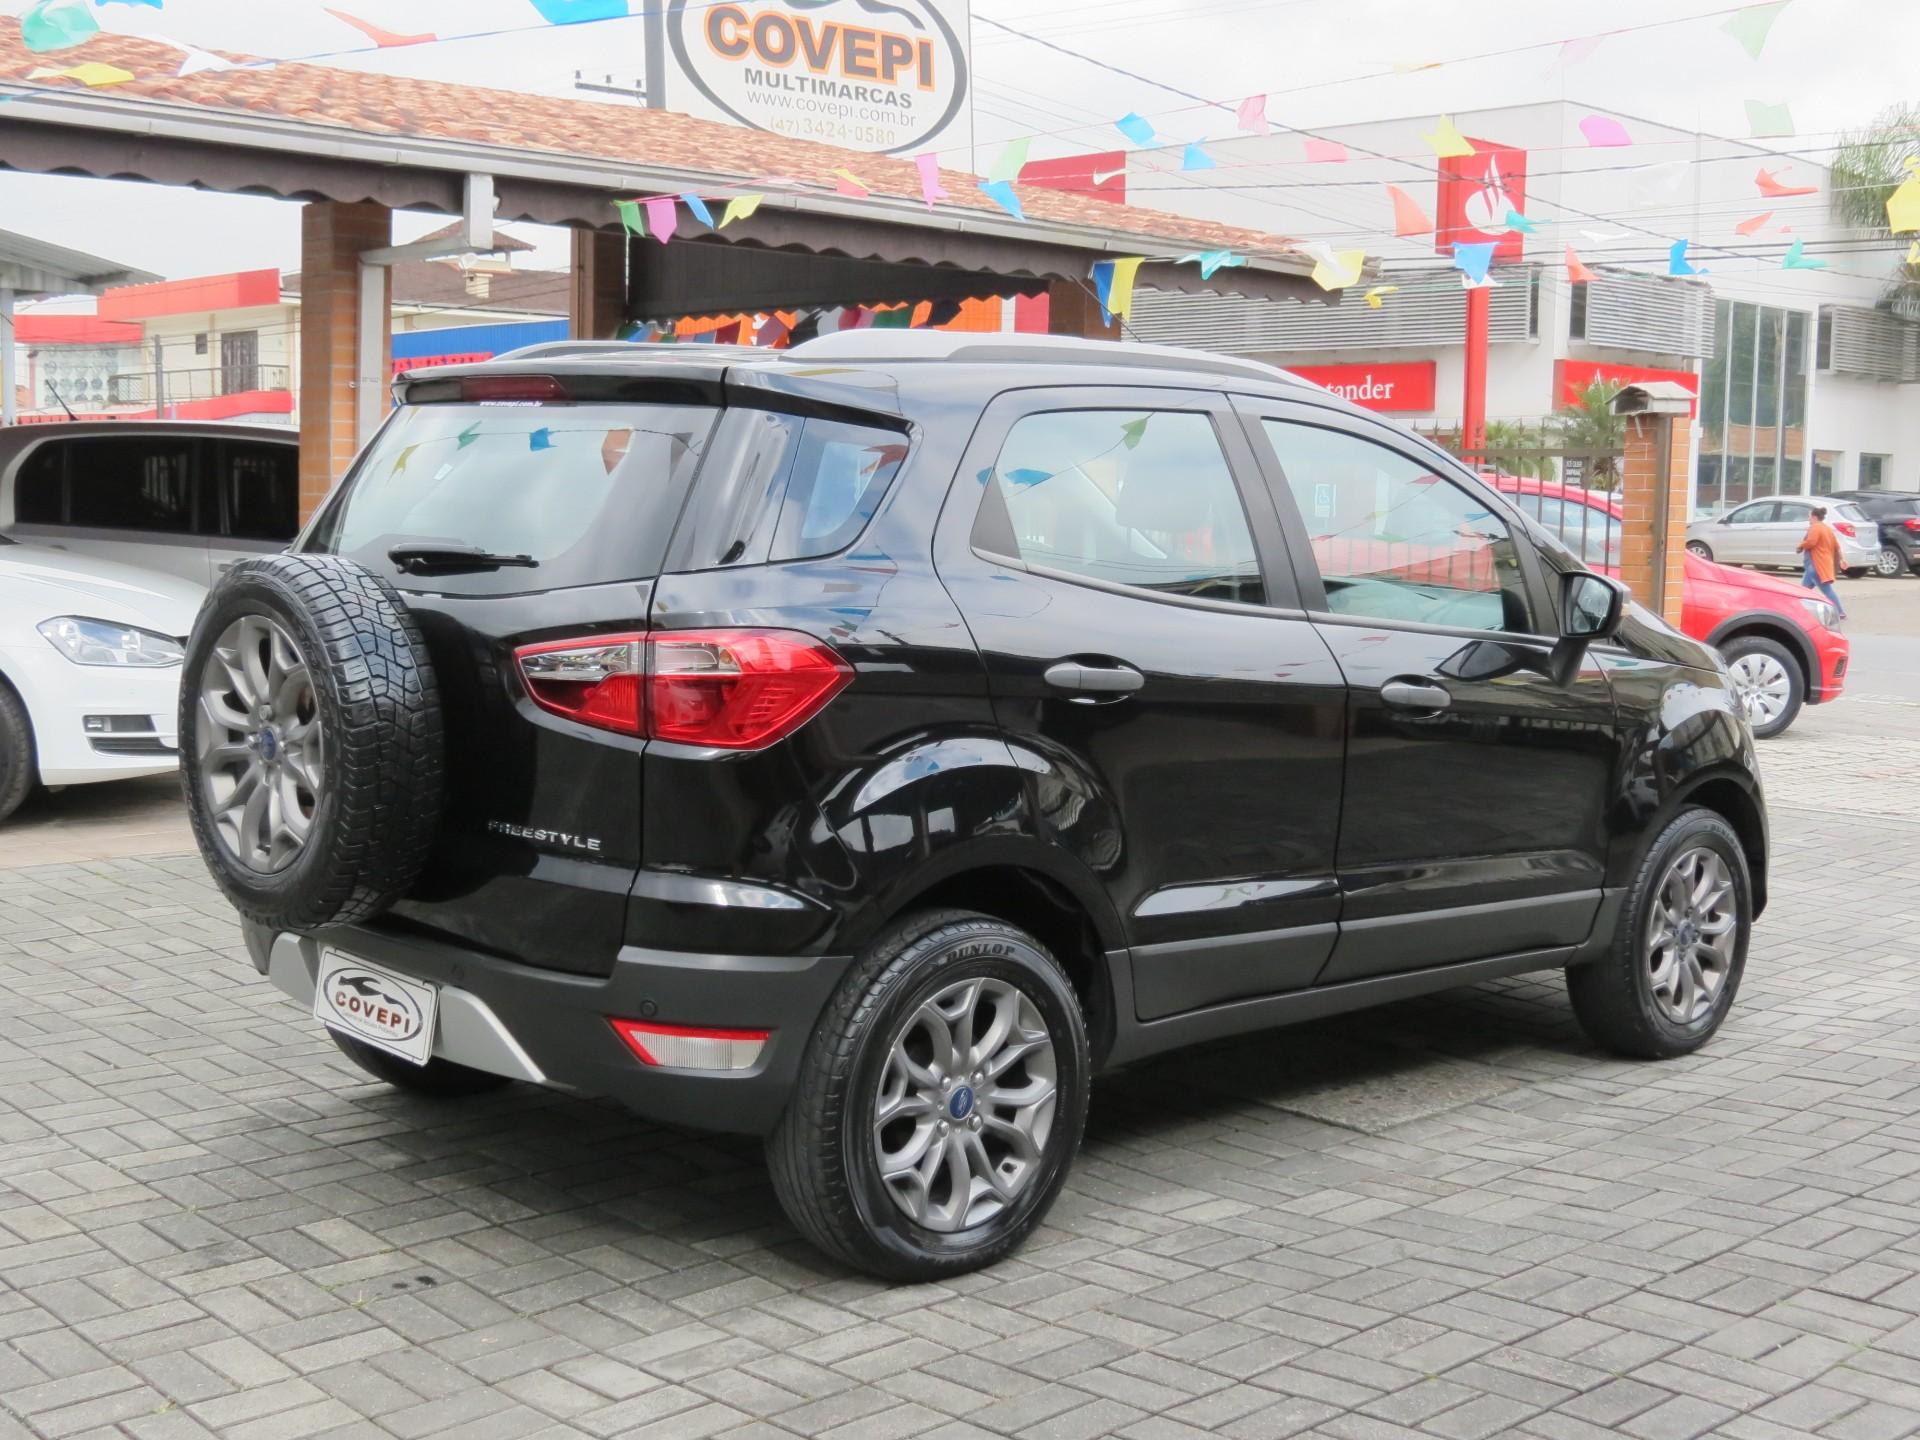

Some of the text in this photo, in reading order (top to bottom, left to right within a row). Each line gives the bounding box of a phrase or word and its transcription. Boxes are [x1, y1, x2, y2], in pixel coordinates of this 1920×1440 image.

[704, 4, 936, 92] COVEPI
[744, 67, 913, 109] MULTIMARCAS
[747, 90, 917, 127] www.covepi.com.br
[488, 819, 602, 851] FREESTYLE
[944, 943, 1016, 961] DUNLOP
[335, 990, 411, 1034] COVEPI
